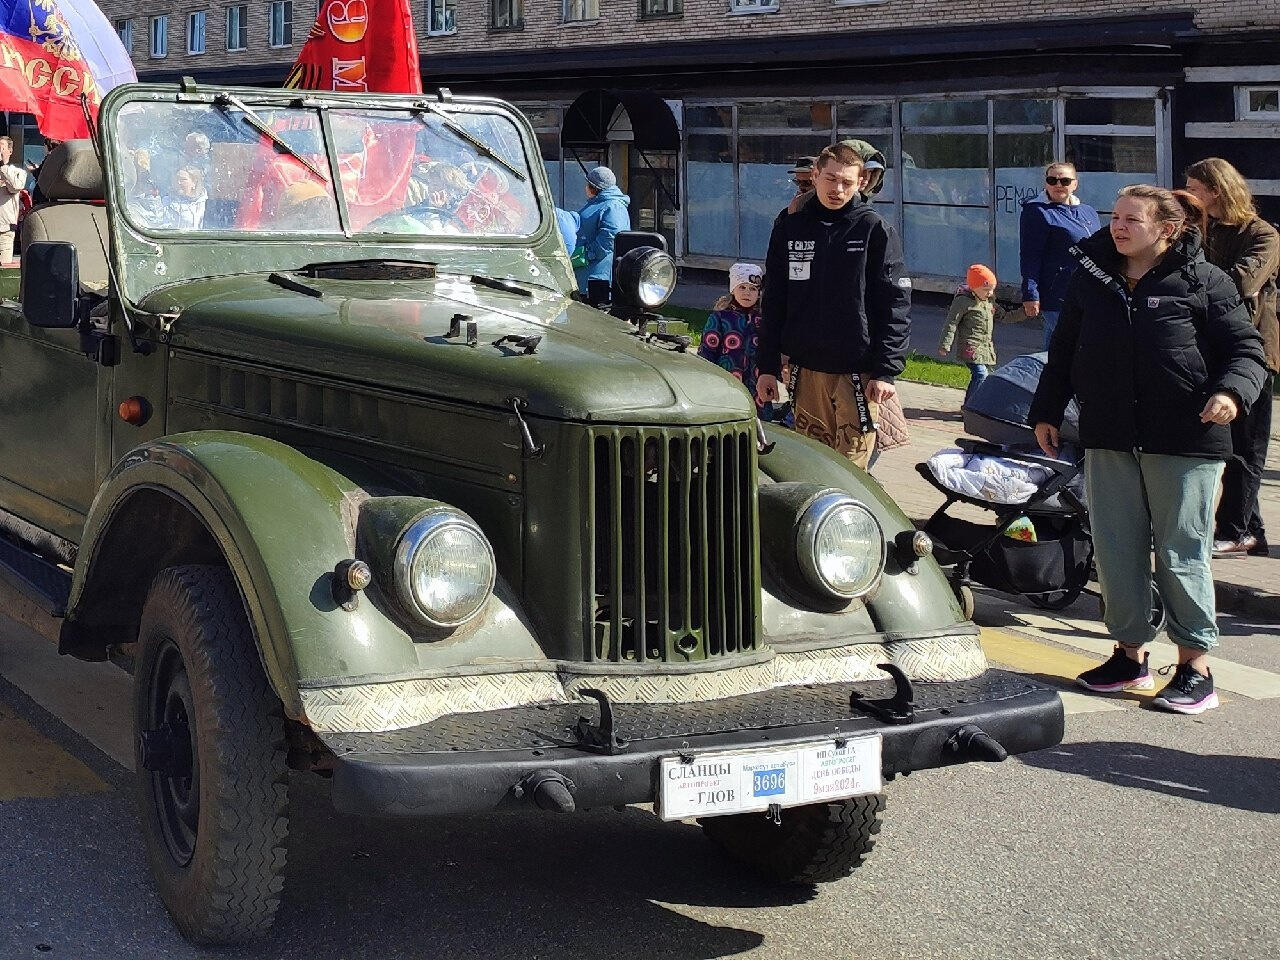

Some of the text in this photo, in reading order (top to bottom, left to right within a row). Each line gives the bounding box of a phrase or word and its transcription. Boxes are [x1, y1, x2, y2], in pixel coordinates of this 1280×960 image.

[668, 762, 732, 781] СЛАНЦЫ
[754, 773, 785, 791] 3696
[697, 789, 736, 806] ГДОВ
